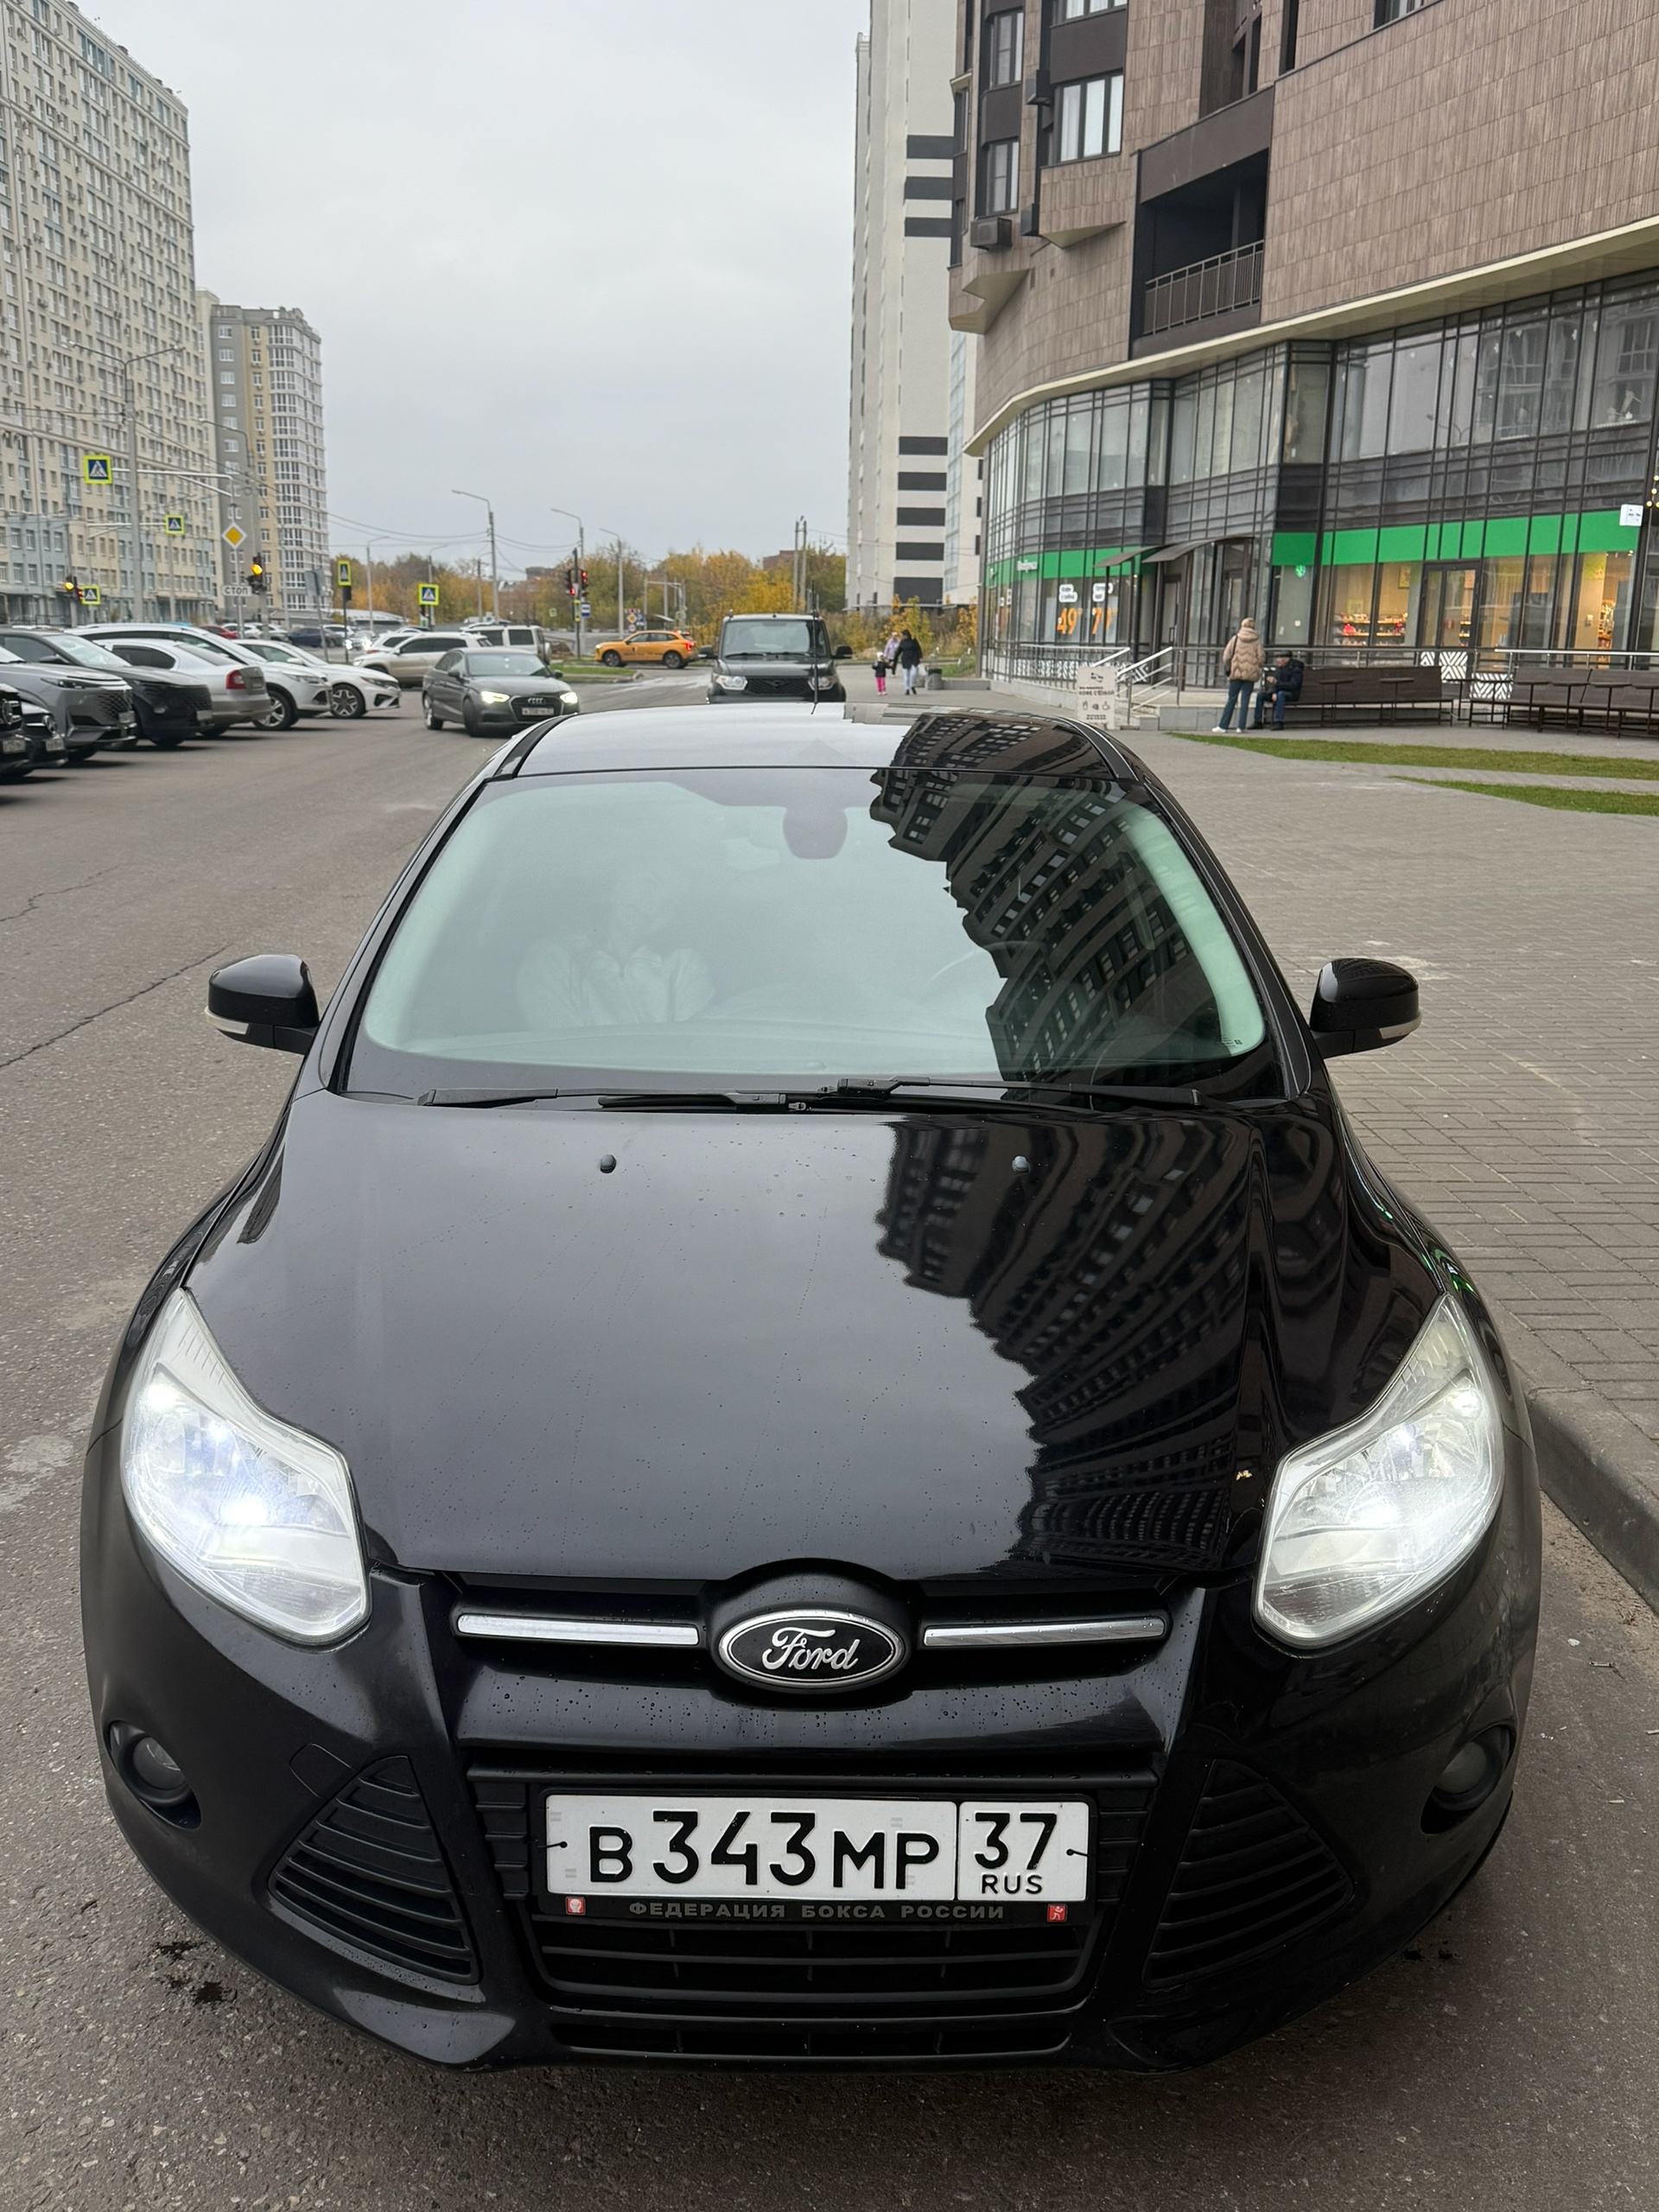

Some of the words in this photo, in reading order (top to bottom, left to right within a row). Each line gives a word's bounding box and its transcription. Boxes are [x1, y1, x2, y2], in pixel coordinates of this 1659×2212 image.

[225, 586, 248, 594] СТОП
[761, 1627, 861, 1671] Ford
[973, 1812, 1058, 1871] 37
[981, 1873, 1044, 1895] RUS
[628, 1901, 786, 1919] ФЕДЕРАЦИЯ
[801, 1903, 887, 1919] БОКСА
[900, 1903, 1005, 1920] РОССИИ
